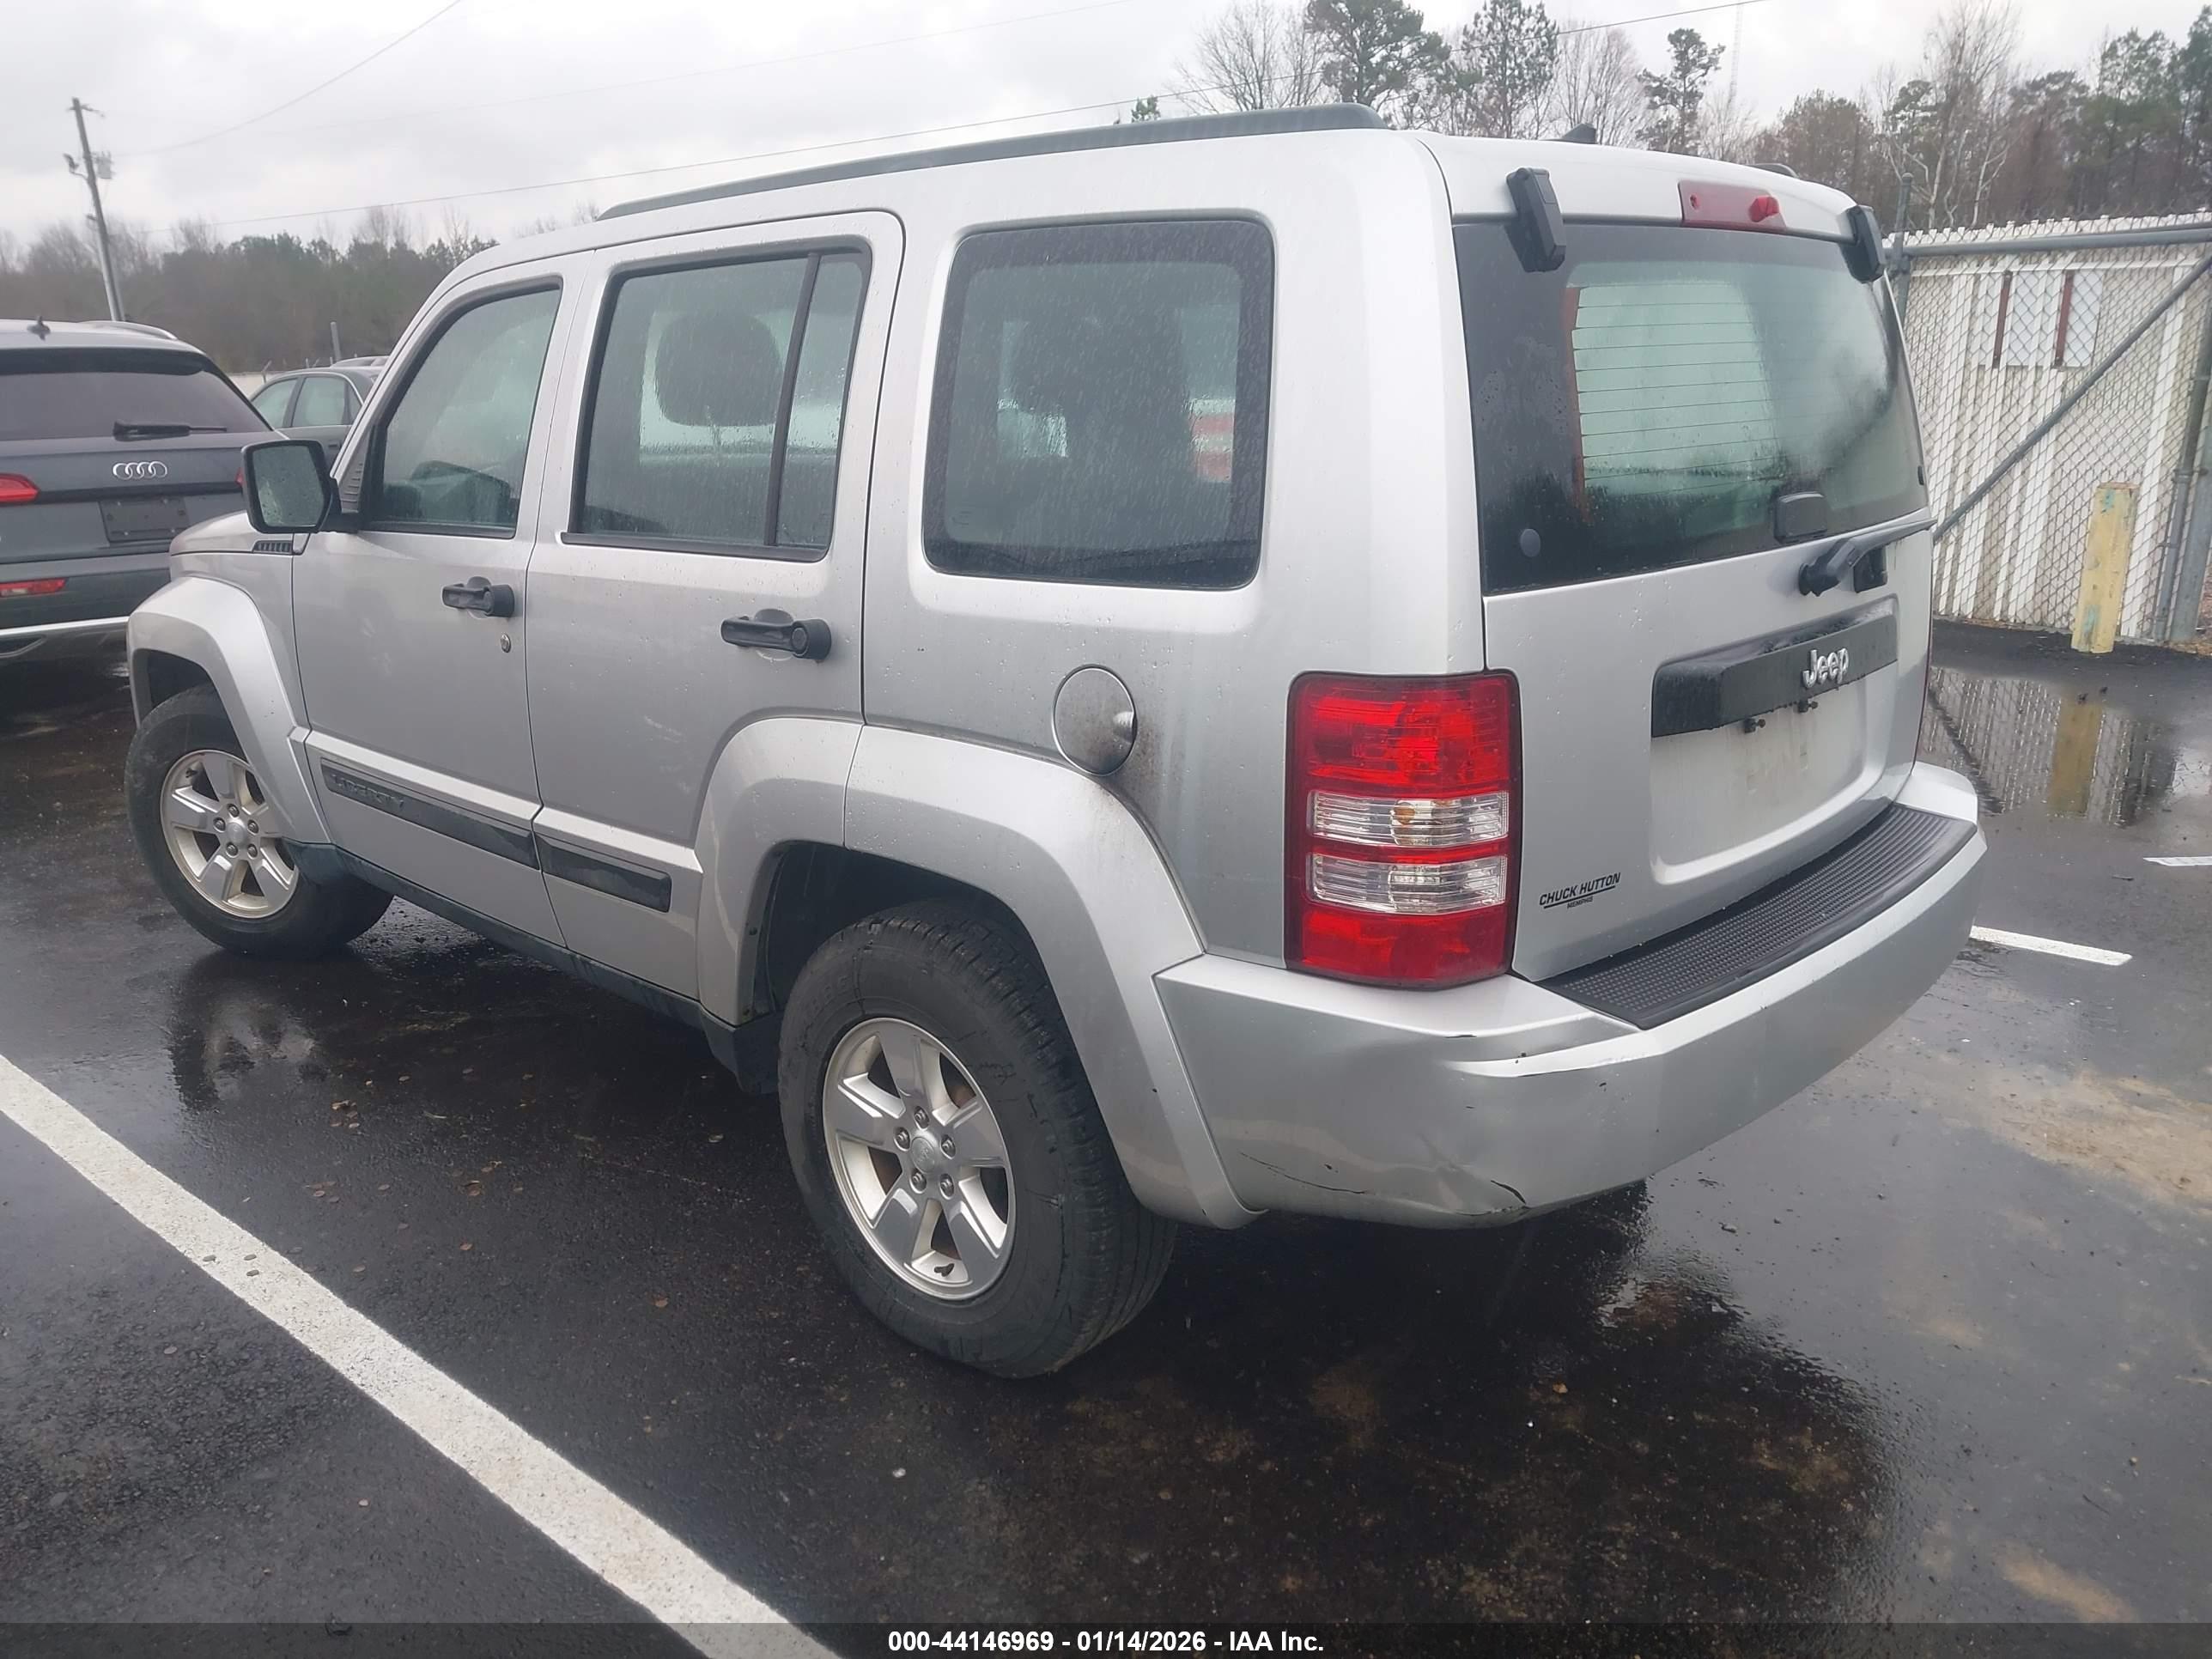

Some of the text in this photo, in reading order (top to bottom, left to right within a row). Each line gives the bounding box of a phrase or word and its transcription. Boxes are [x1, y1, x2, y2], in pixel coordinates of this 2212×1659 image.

[1802, 647, 1849, 687] Jeep
[1539, 872, 1621, 906] CHUCK HUTTON
